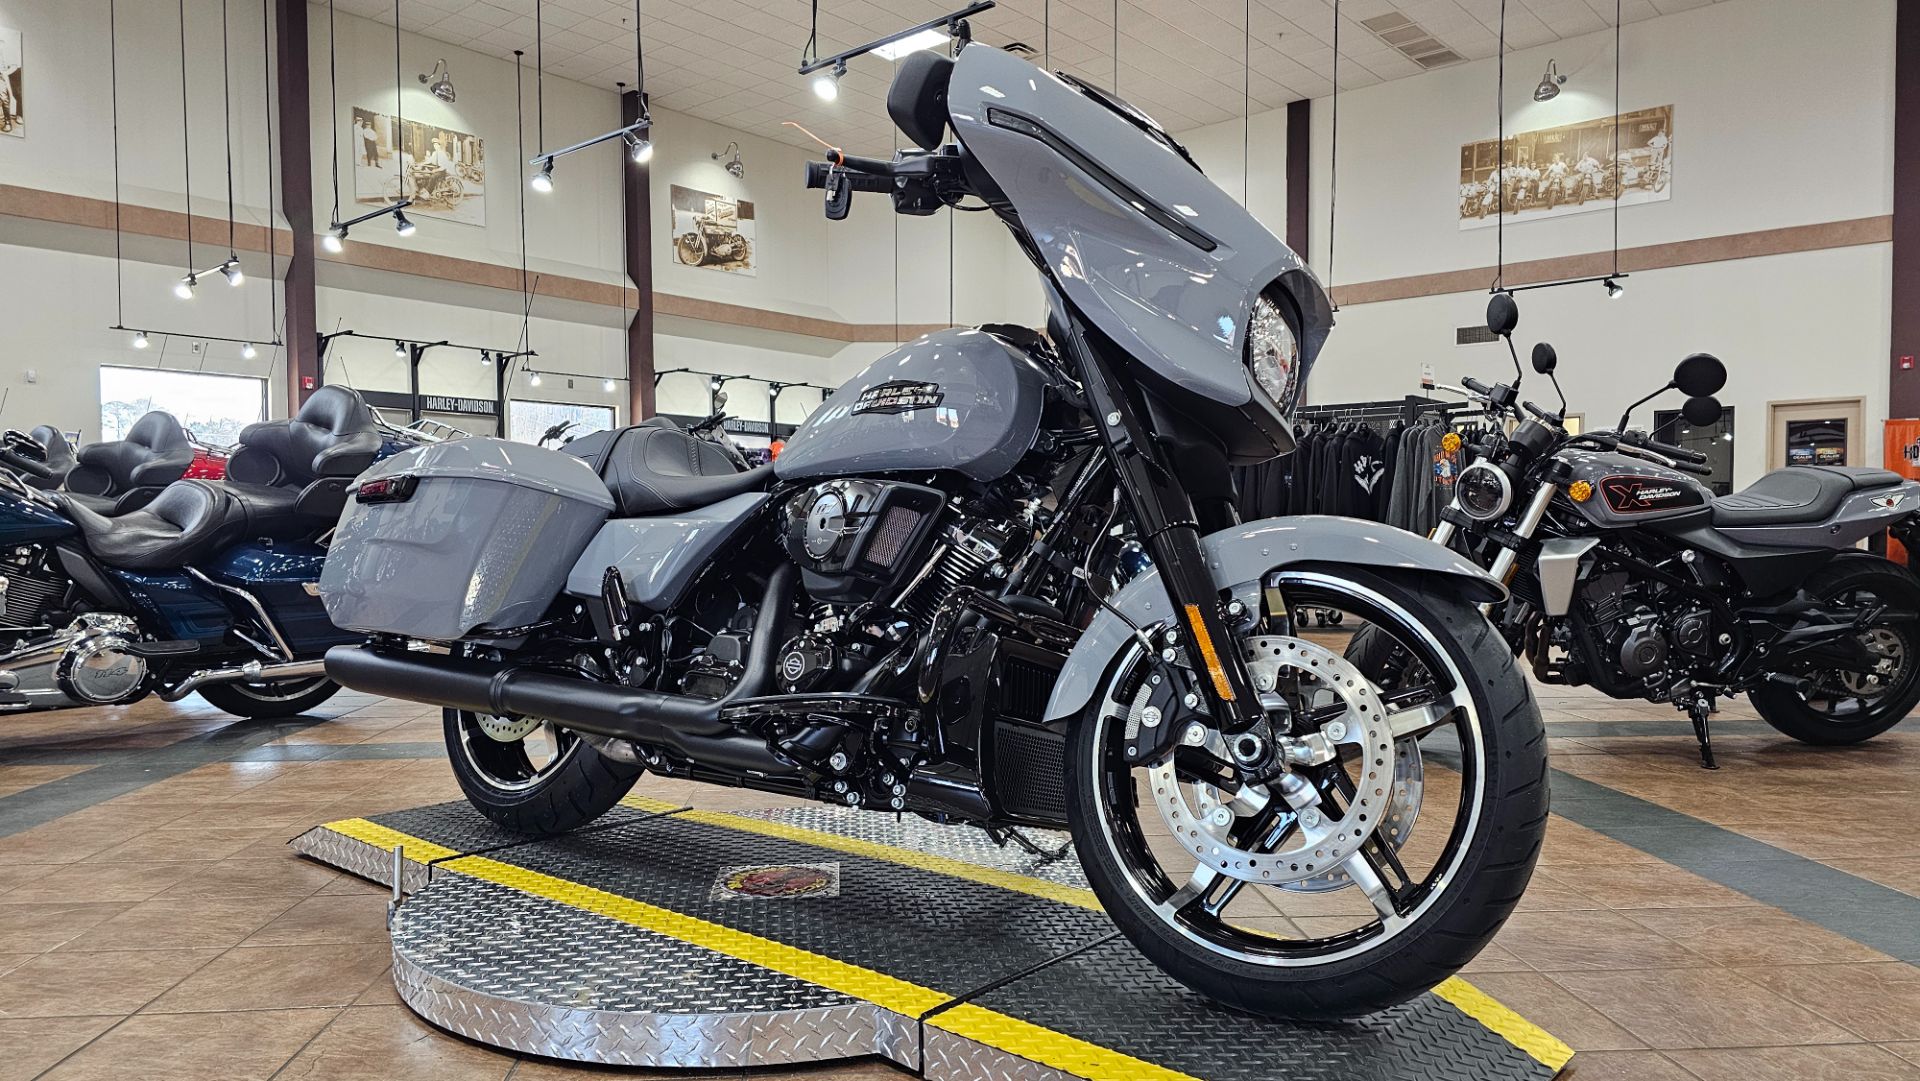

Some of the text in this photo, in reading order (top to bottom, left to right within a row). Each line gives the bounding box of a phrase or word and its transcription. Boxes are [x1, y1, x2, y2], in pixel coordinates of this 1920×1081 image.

[426, 396, 495, 414] HARLEY-DAVIDSON
[723, 419, 769, 433] HARLEY-DAVIDSON
[1639, 491, 1681, 501] DAVIDSON
